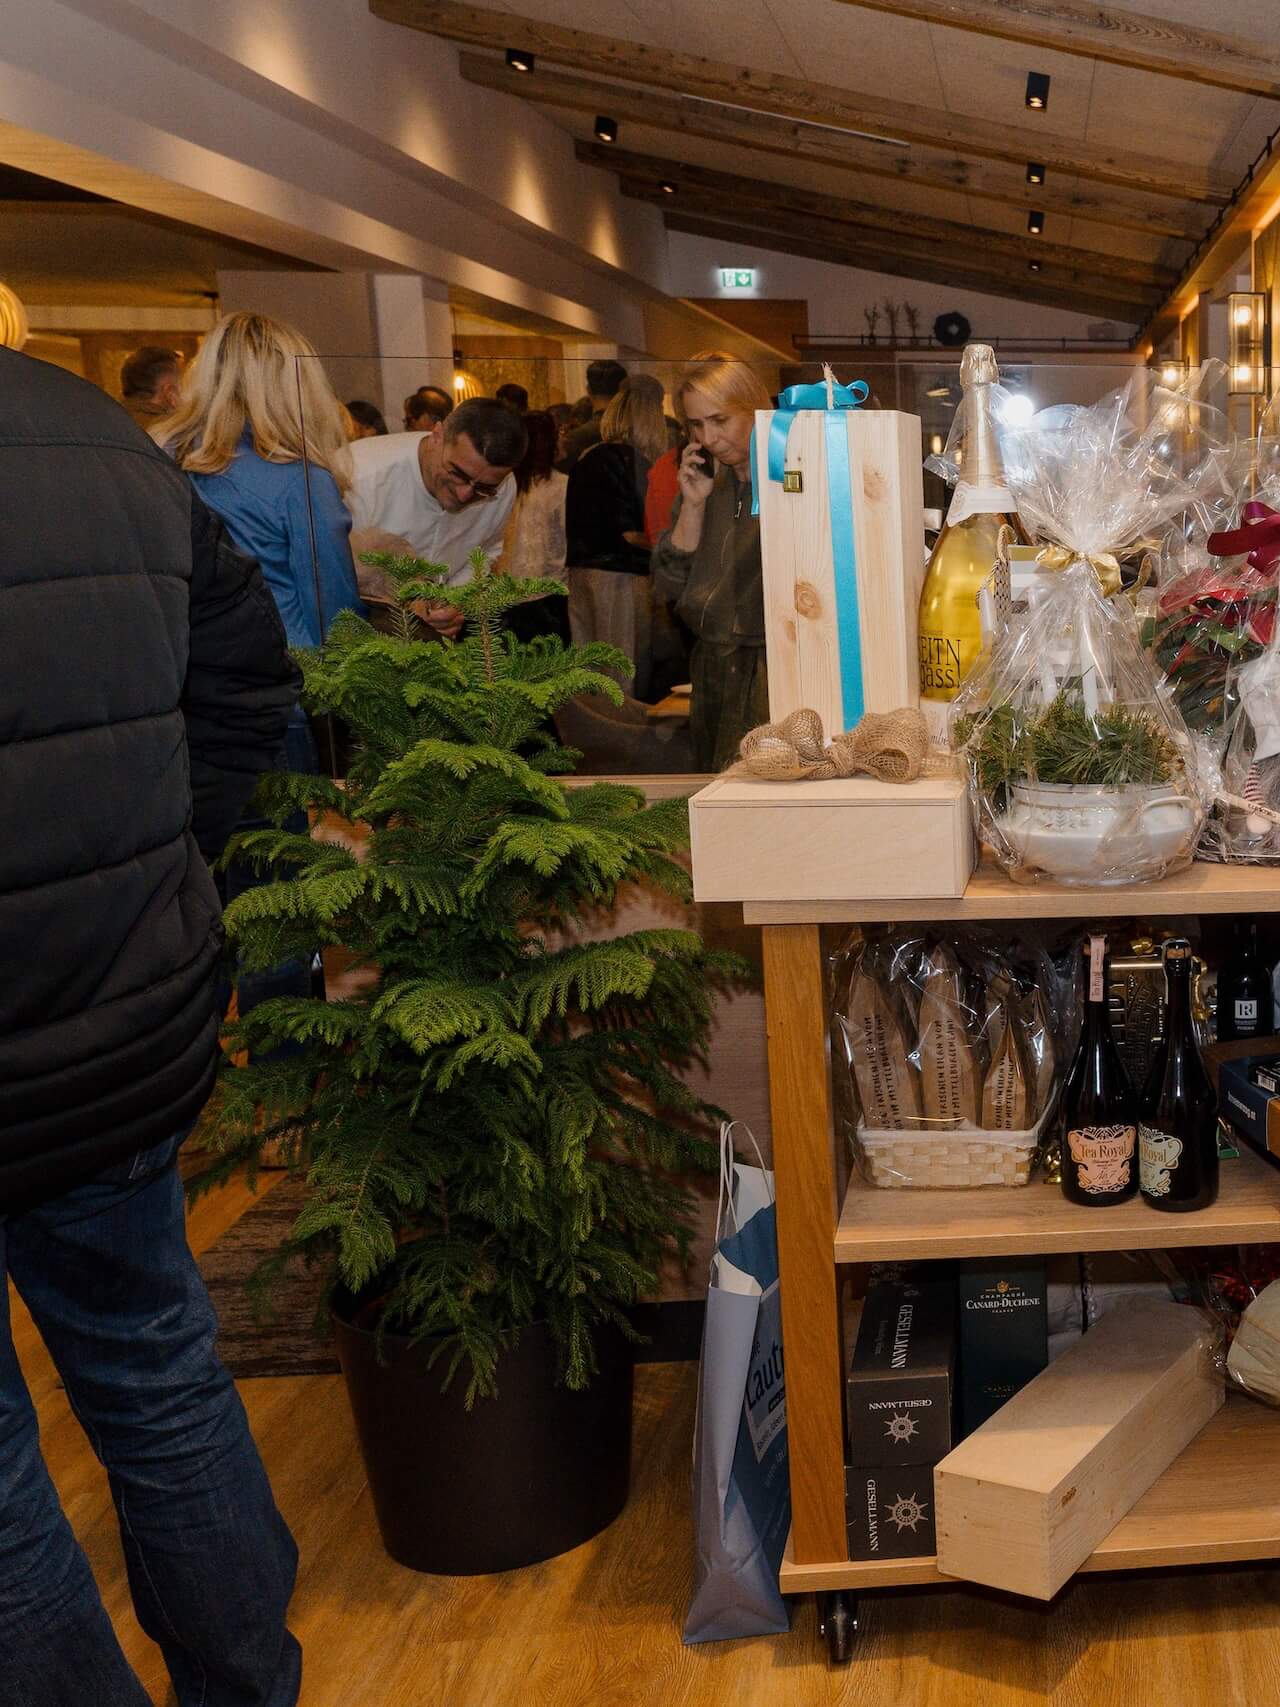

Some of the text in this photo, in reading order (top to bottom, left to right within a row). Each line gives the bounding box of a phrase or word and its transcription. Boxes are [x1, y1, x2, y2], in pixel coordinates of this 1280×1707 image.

[1080, 1141, 1127, 1160] Tea Royal
[980, 1291, 1025, 1299] CHAMPAGNE
[891, 1304, 914, 1369] GESELLMANN
[868, 1399, 933, 1410] GESELLMANN
[866, 1479, 879, 1551] GESELLMANN
